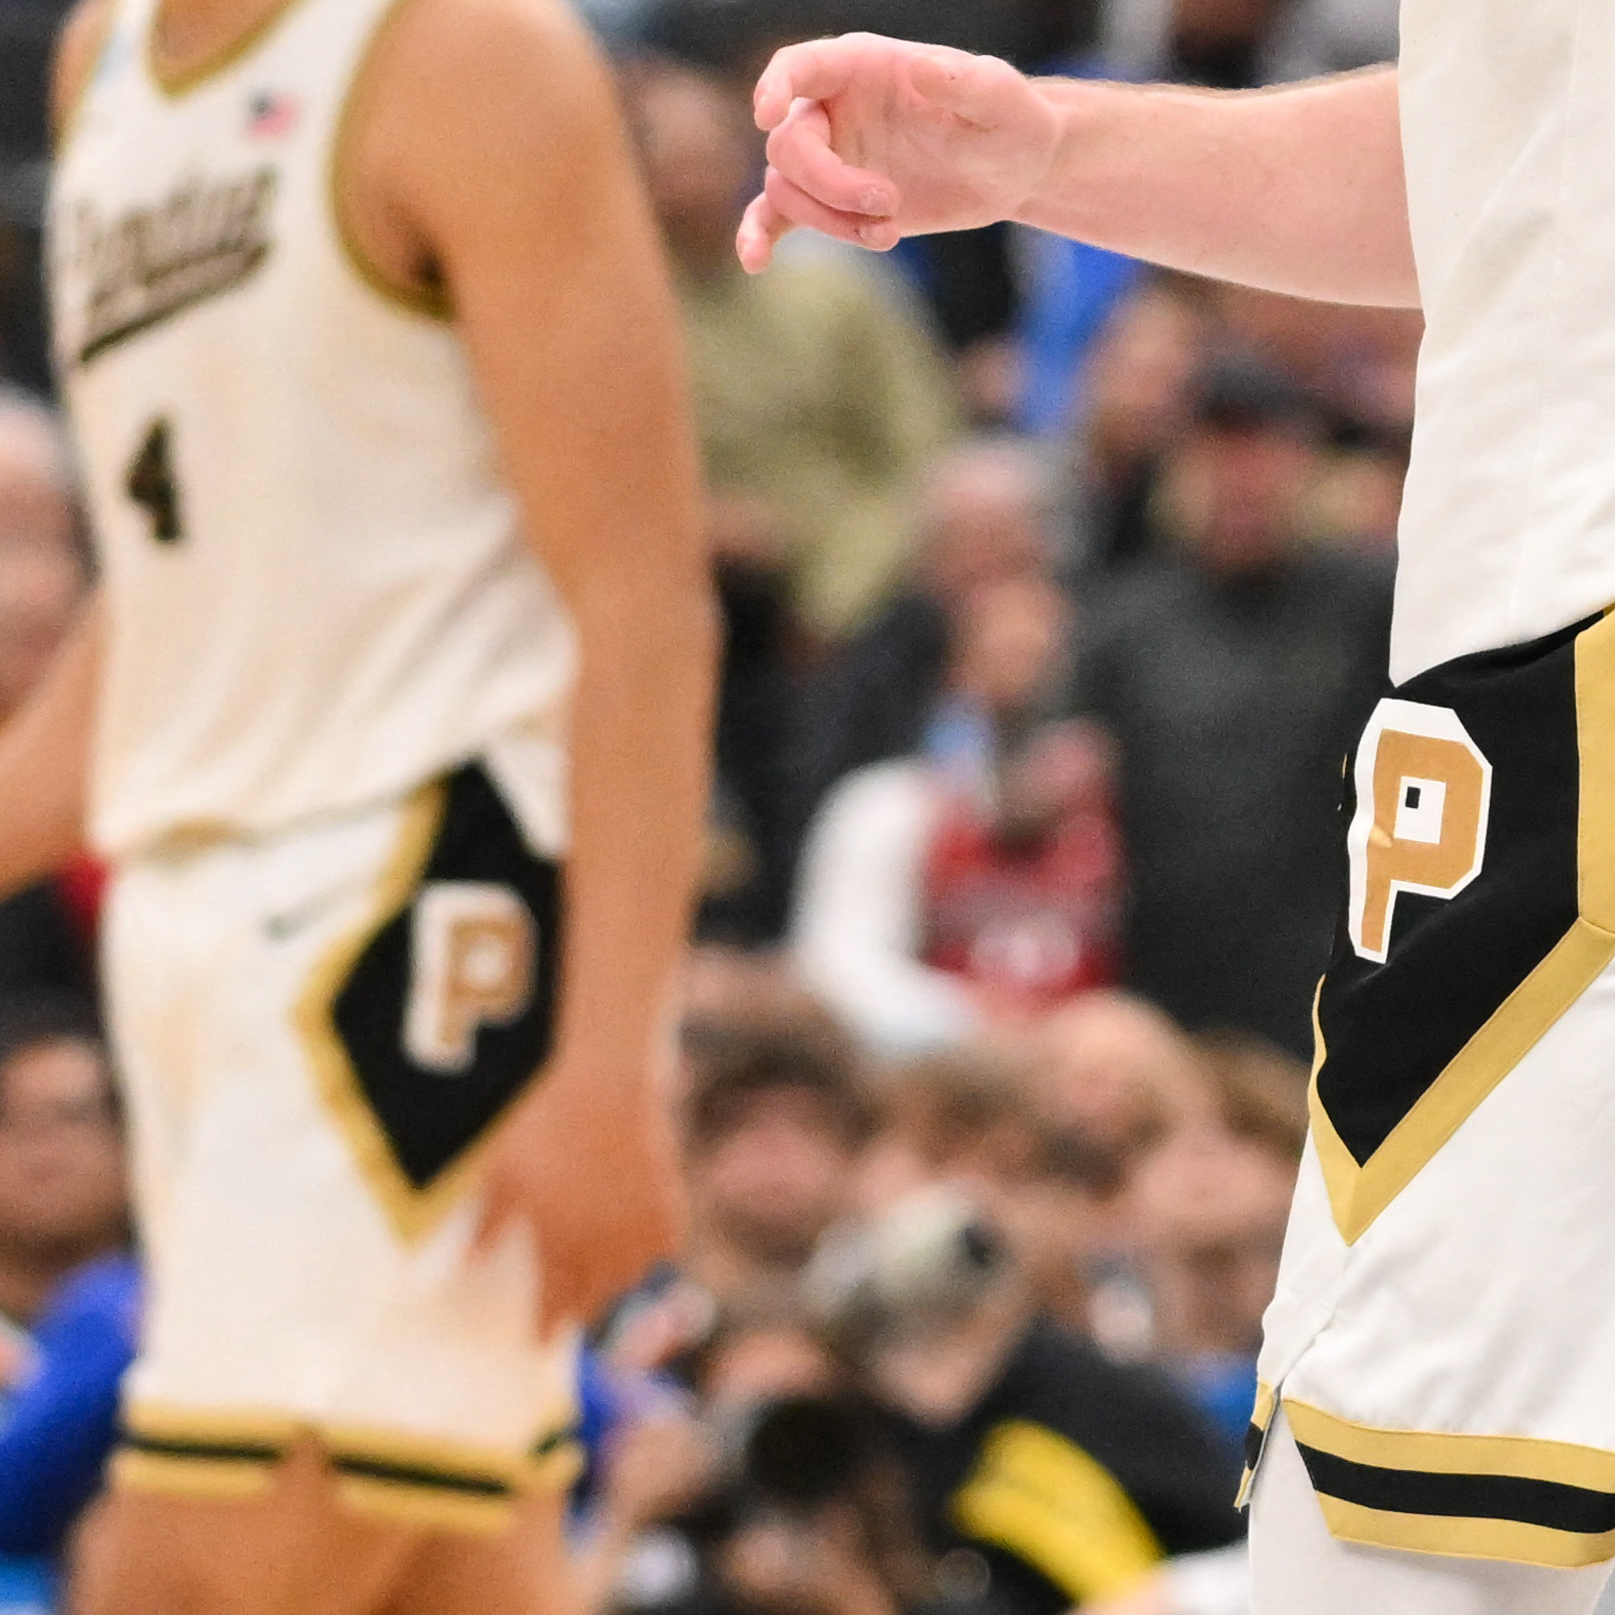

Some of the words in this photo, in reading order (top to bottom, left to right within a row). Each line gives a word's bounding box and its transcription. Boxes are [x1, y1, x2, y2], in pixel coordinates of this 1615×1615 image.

[125, 415, 185, 545] 4
[1348, 698, 1492, 964] P
[405, 881, 539, 1075] P
